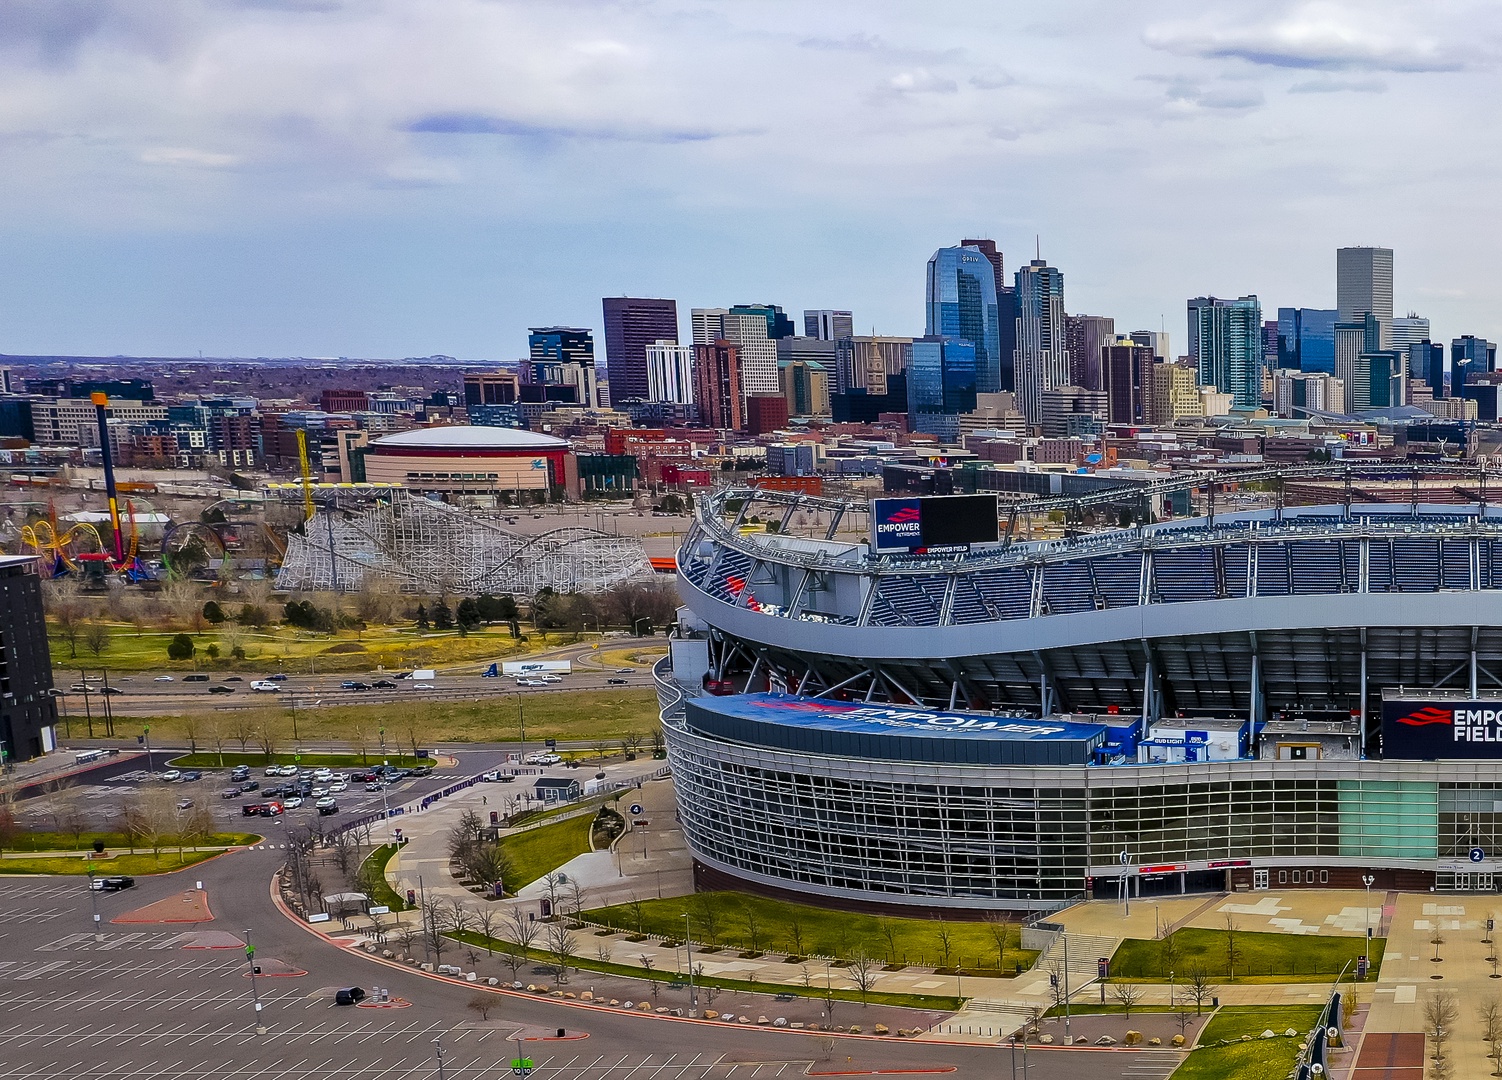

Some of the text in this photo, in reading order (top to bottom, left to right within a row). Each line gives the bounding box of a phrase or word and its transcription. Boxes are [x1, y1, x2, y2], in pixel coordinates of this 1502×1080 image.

[877, 522, 920, 533] EMPOWER
[927, 546, 953, 554] EMPOWER
[843, 707, 1066, 736] EMPOWER
[1473, 851, 1480, 860] 2
